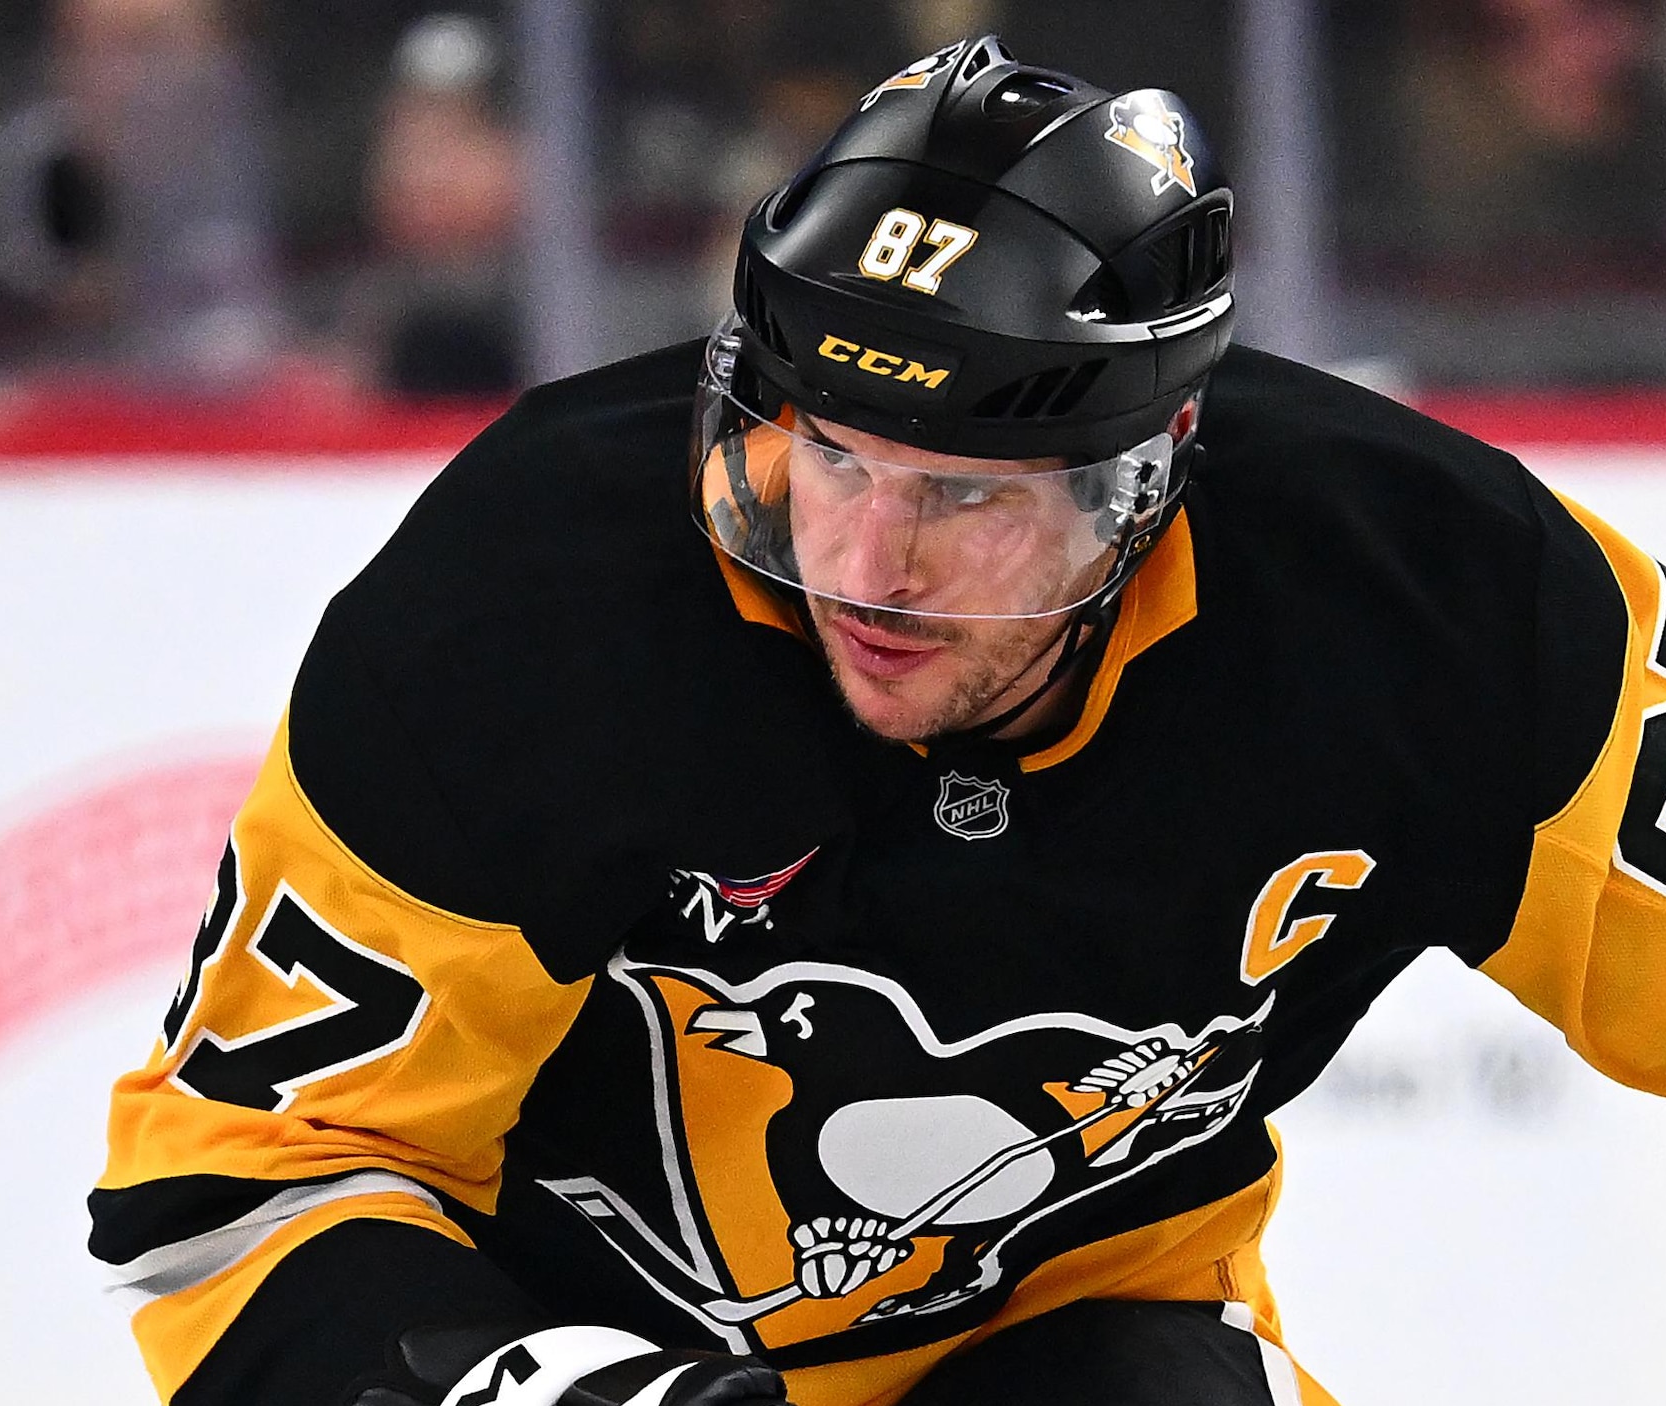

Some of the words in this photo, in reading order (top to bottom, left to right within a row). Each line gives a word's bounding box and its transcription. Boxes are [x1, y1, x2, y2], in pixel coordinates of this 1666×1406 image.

[858, 207, 978, 295] 87
[817, 333, 951, 391] CCM
[951, 795, 994, 823] NHL
[1240, 849, 1377, 986] C
